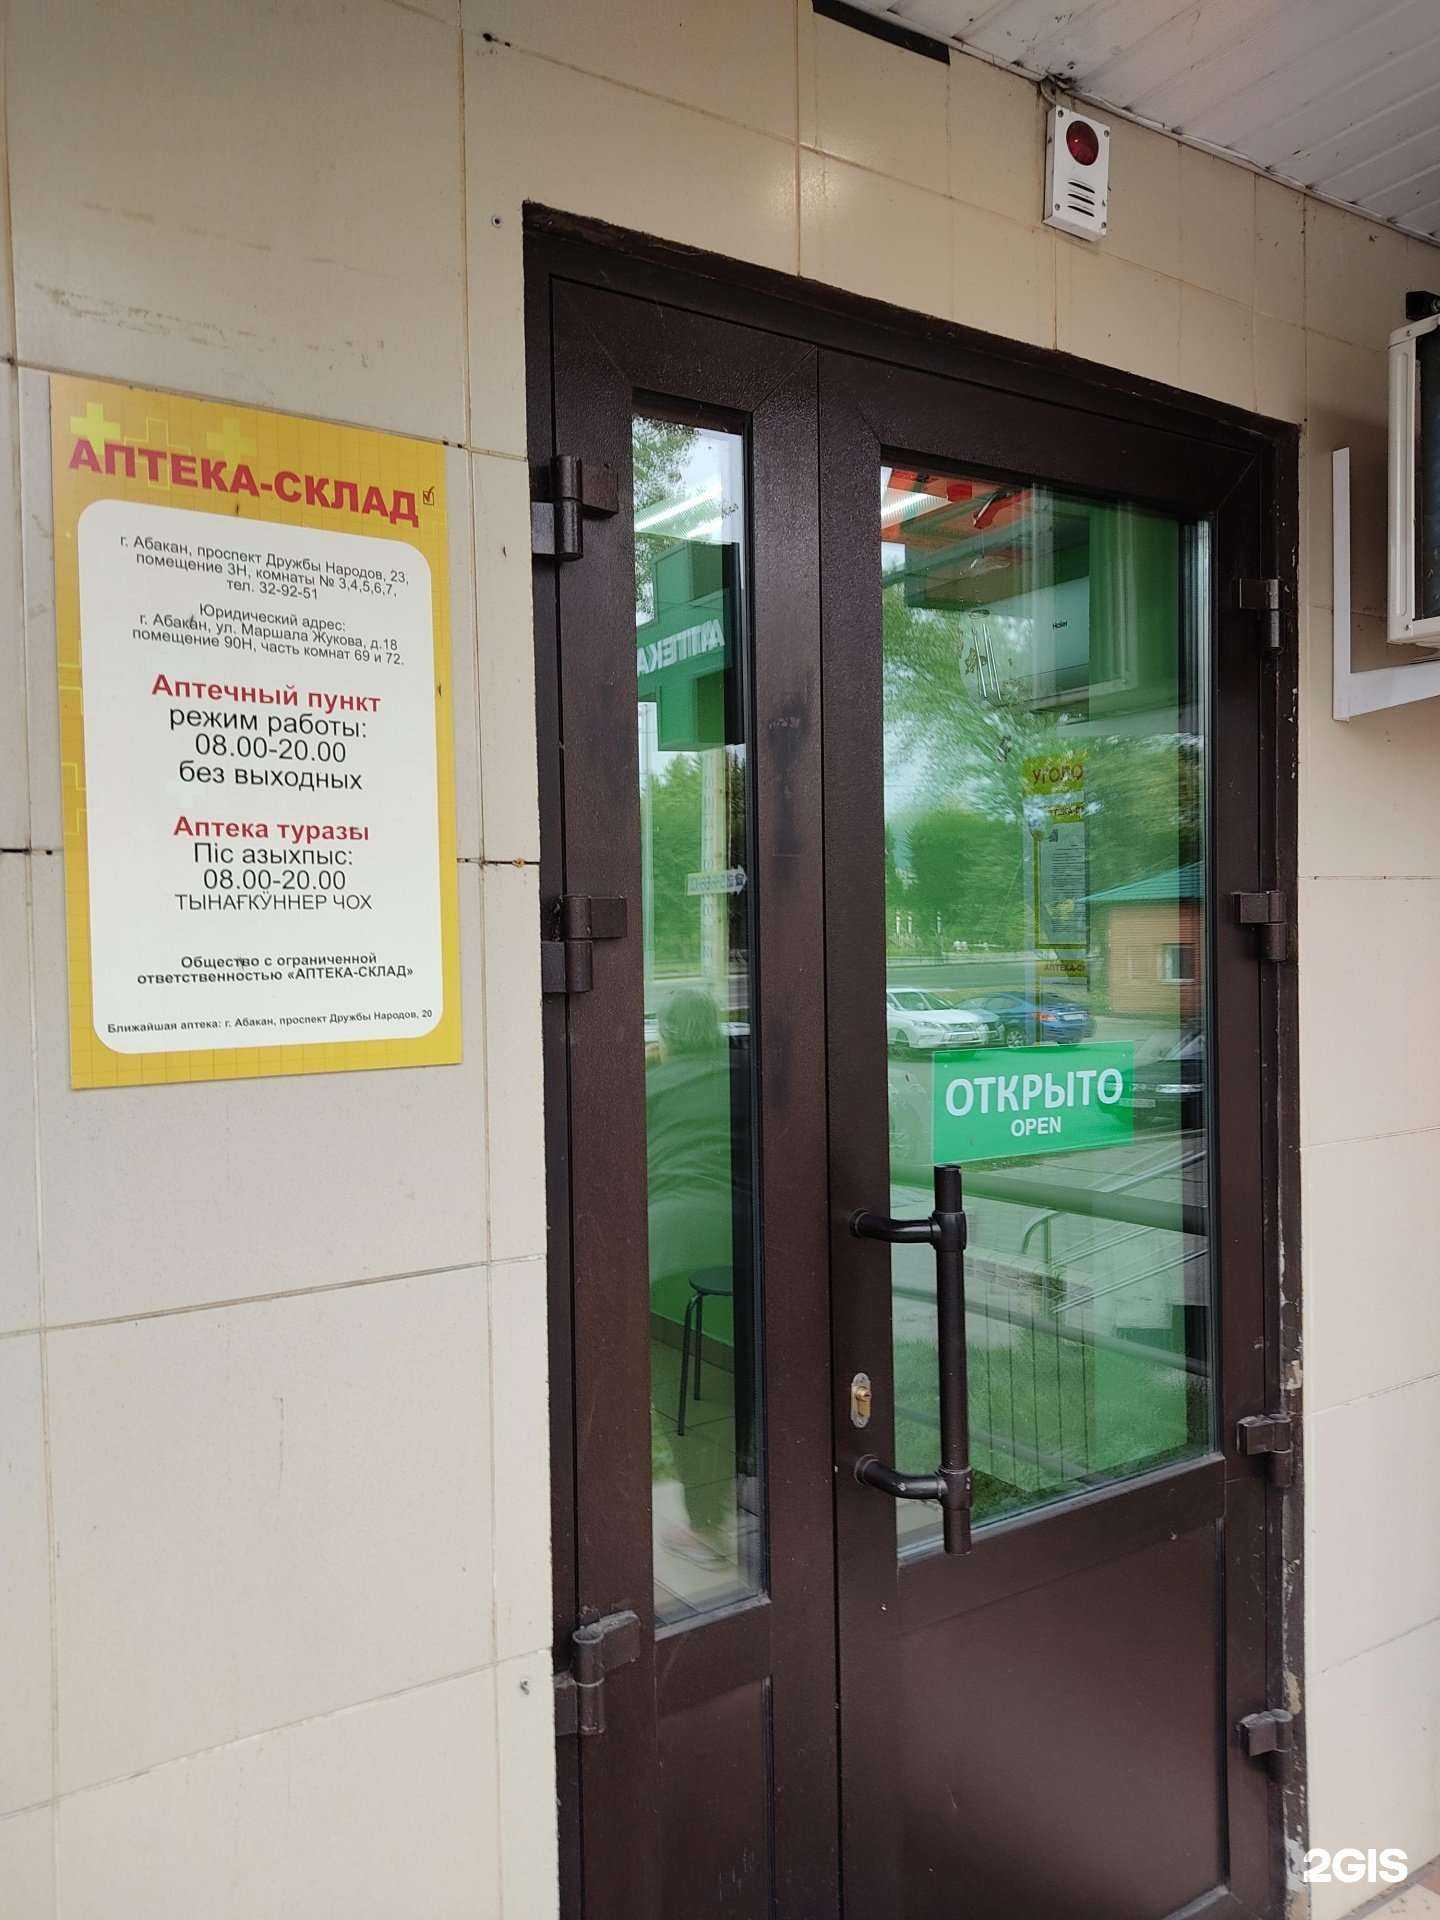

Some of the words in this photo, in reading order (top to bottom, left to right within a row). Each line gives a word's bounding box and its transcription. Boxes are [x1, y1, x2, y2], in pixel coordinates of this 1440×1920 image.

[69, 438, 419, 528] АПТЕКА-СКЛАД
[120, 535, 129, 548] г.
[134, 536, 192, 557] Абакан,
[197, 545, 261, 566] проспект
[266, 553, 321, 573] Дружбы
[326, 561, 386, 582] Народов,
[390, 570, 409, 584] 23,
[136, 554, 223, 575] помещение
[256, 568, 314, 585] комнаты
[319, 575, 335, 588] №
[227, 579, 255, 593] тел.
[259, 582, 318, 600] 32-92-51
[140, 614, 148, 625] г.
[153, 614, 212, 634] Абакан,
[216, 622, 237, 636] ул.
[241, 622, 308, 643] Маршала
[313, 632, 367, 650] Жукова,
[200, 603, 298, 626] Юридический
[302, 616, 346, 634] адрес:
[132, 629, 219, 648] помещение
[261, 641, 300, 656] часть
[304, 644, 350, 660] комнат
[354, 650, 370, 662] 69
[374, 652, 382, 663] и
[386, 652, 404, 665] 72.
[152, 674, 298, 707] Аптечный
[308, 690, 381, 715] пункт
[170, 707, 258, 730] режим
[268, 714, 367, 738] работы:
[195, 734, 346, 763] 08.00-20.00
[179, 760, 225, 784] без
[235, 767, 362, 791] выходных
[173, 816, 268, 839] Аптека
[242, 847, 353, 866] азыхпыс:
[203, 869, 346, 890] 08.00-20.00
[333, 894, 372, 910] ЧОХ
[137, 969, 282, 985] ответственностью
[288, 965, 413, 980] «АПТЕКА-СКЛАД»
[181, 955, 259, 969] Общество
[264, 957, 272, 967] с
[277, 952, 377, 967] ограниченной
[107, 1022, 178, 1033] Ближайшая
[180, 1019, 221, 1030] аптека:
[225, 1020, 231, 1028] г.
[235, 1016, 277, 1029] Абакан,
[280, 1014, 327, 1026] проспект
[329, 1011, 371, 1024] Дружбы
[374, 1010, 420, 1021] Народов,
[422, 1009, 432, 1018] 20
[945, 1068, 1124, 1117] ОТКРЫТО
[1010, 1116, 1062, 1137] OPEN
